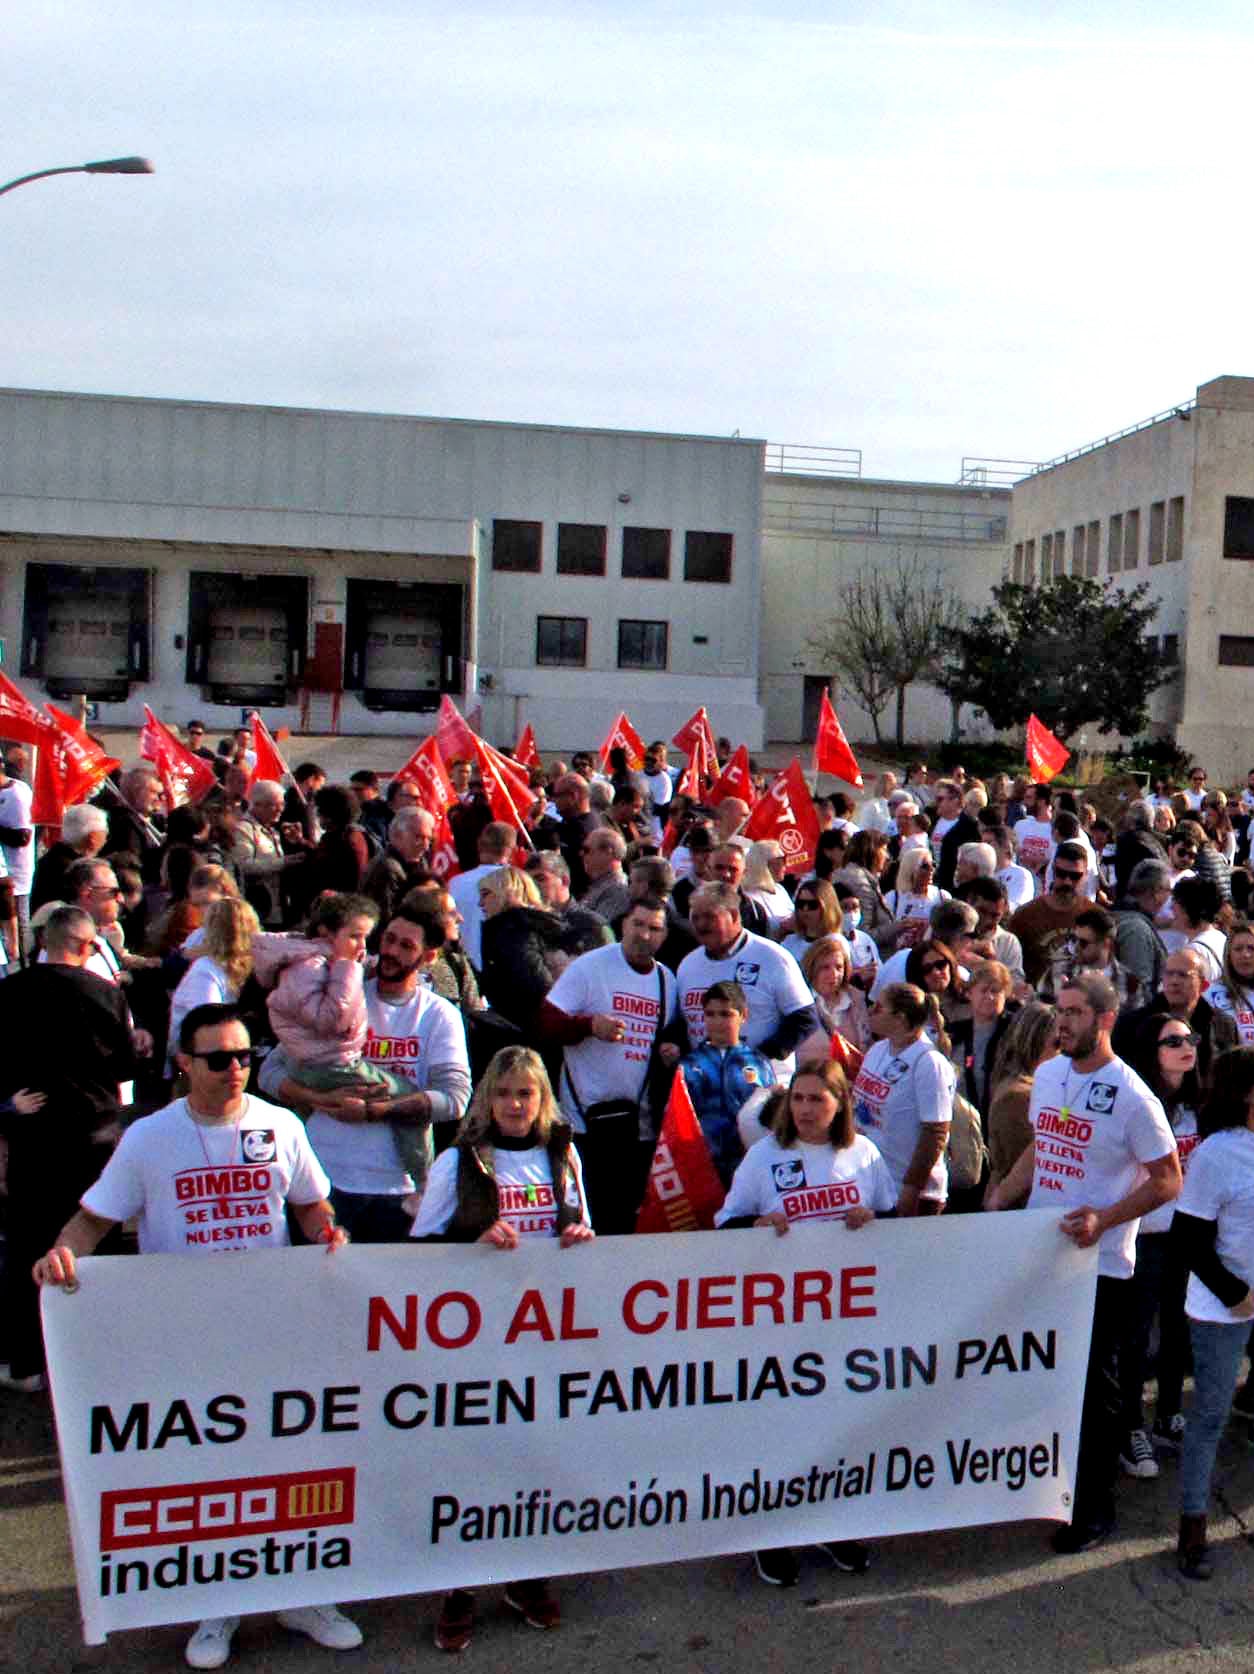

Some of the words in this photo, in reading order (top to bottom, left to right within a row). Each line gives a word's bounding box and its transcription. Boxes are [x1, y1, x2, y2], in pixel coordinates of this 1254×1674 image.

[1036, 1112, 1093, 1143] BIMBO
[175, 1168, 272, 1201] BIMBO
[783, 1184, 862, 1218] BIMBO
[185, 1207, 209, 1225] SE
[213, 1202, 270, 1220] LLEVA
[185, 1222, 273, 1246] NUESTRO
[367, 1291, 482, 1351] NO
[504, 1287, 599, 1344] AL
[622, 1265, 878, 1335] CIERRE
[90, 1395, 247, 1455] MAS
[271, 1386, 361, 1438] DE
[383, 1376, 536, 1431] CIEN
[558, 1351, 827, 1420] FAMILIAS
[845, 1343, 938, 1393] SIN
[955, 1329, 1057, 1380] PAN
[430, 1477, 688, 1544] Panificación
[701, 1452, 876, 1521] Industrial
[886, 1446, 936, 1492] De
[946, 1431, 1060, 1491] Vergel
[113, 1487, 277, 1537] CCOO
[100, 1530, 352, 1598] industria
